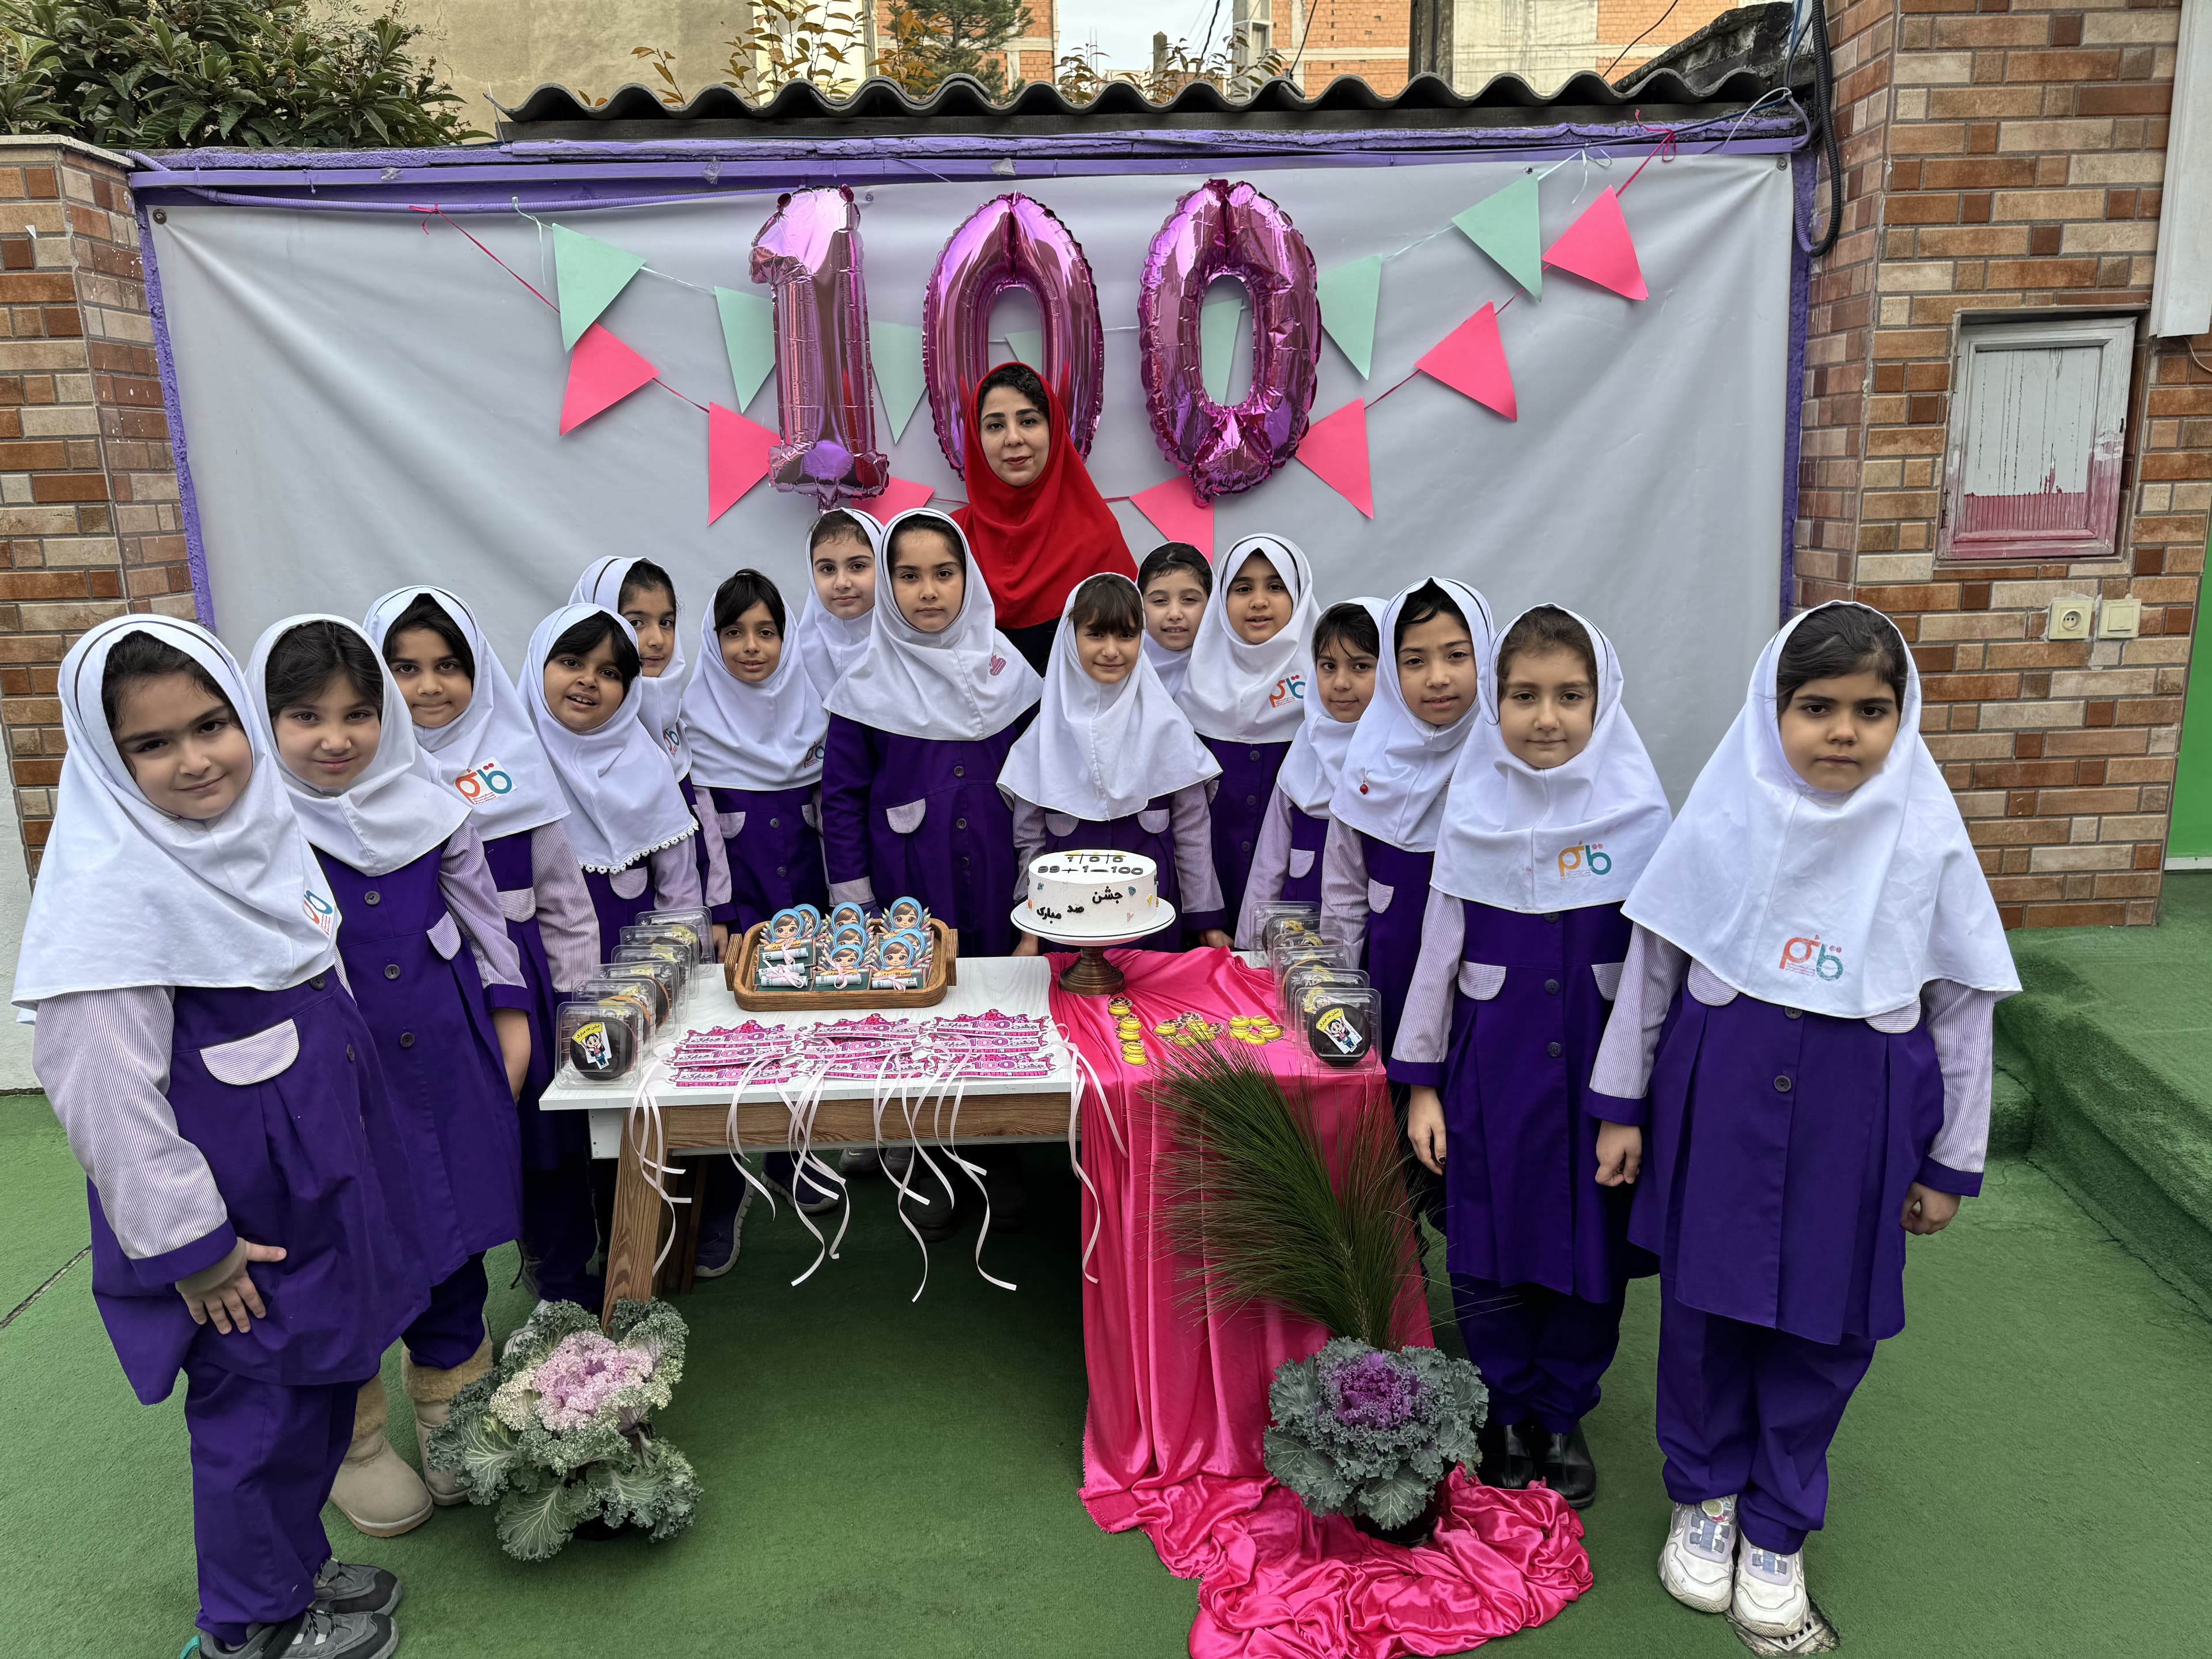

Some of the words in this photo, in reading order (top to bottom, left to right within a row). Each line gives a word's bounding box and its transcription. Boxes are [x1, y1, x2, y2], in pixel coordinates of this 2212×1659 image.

[1092, 886, 1123, 904] جشن
[1067, 905, 1084, 913] صد
[1037, 907, 1062, 923] مبارک
[971, 1021, 1010, 1029] 100
[724, 1033, 764, 1042] 100
[969, 1037, 1009, 1046] 100
[839, 1040, 881, 1051] 100
[712, 1048, 755, 1058] 100
[850, 1062, 892, 1071] 100
[972, 1060, 1015, 1069] 100
